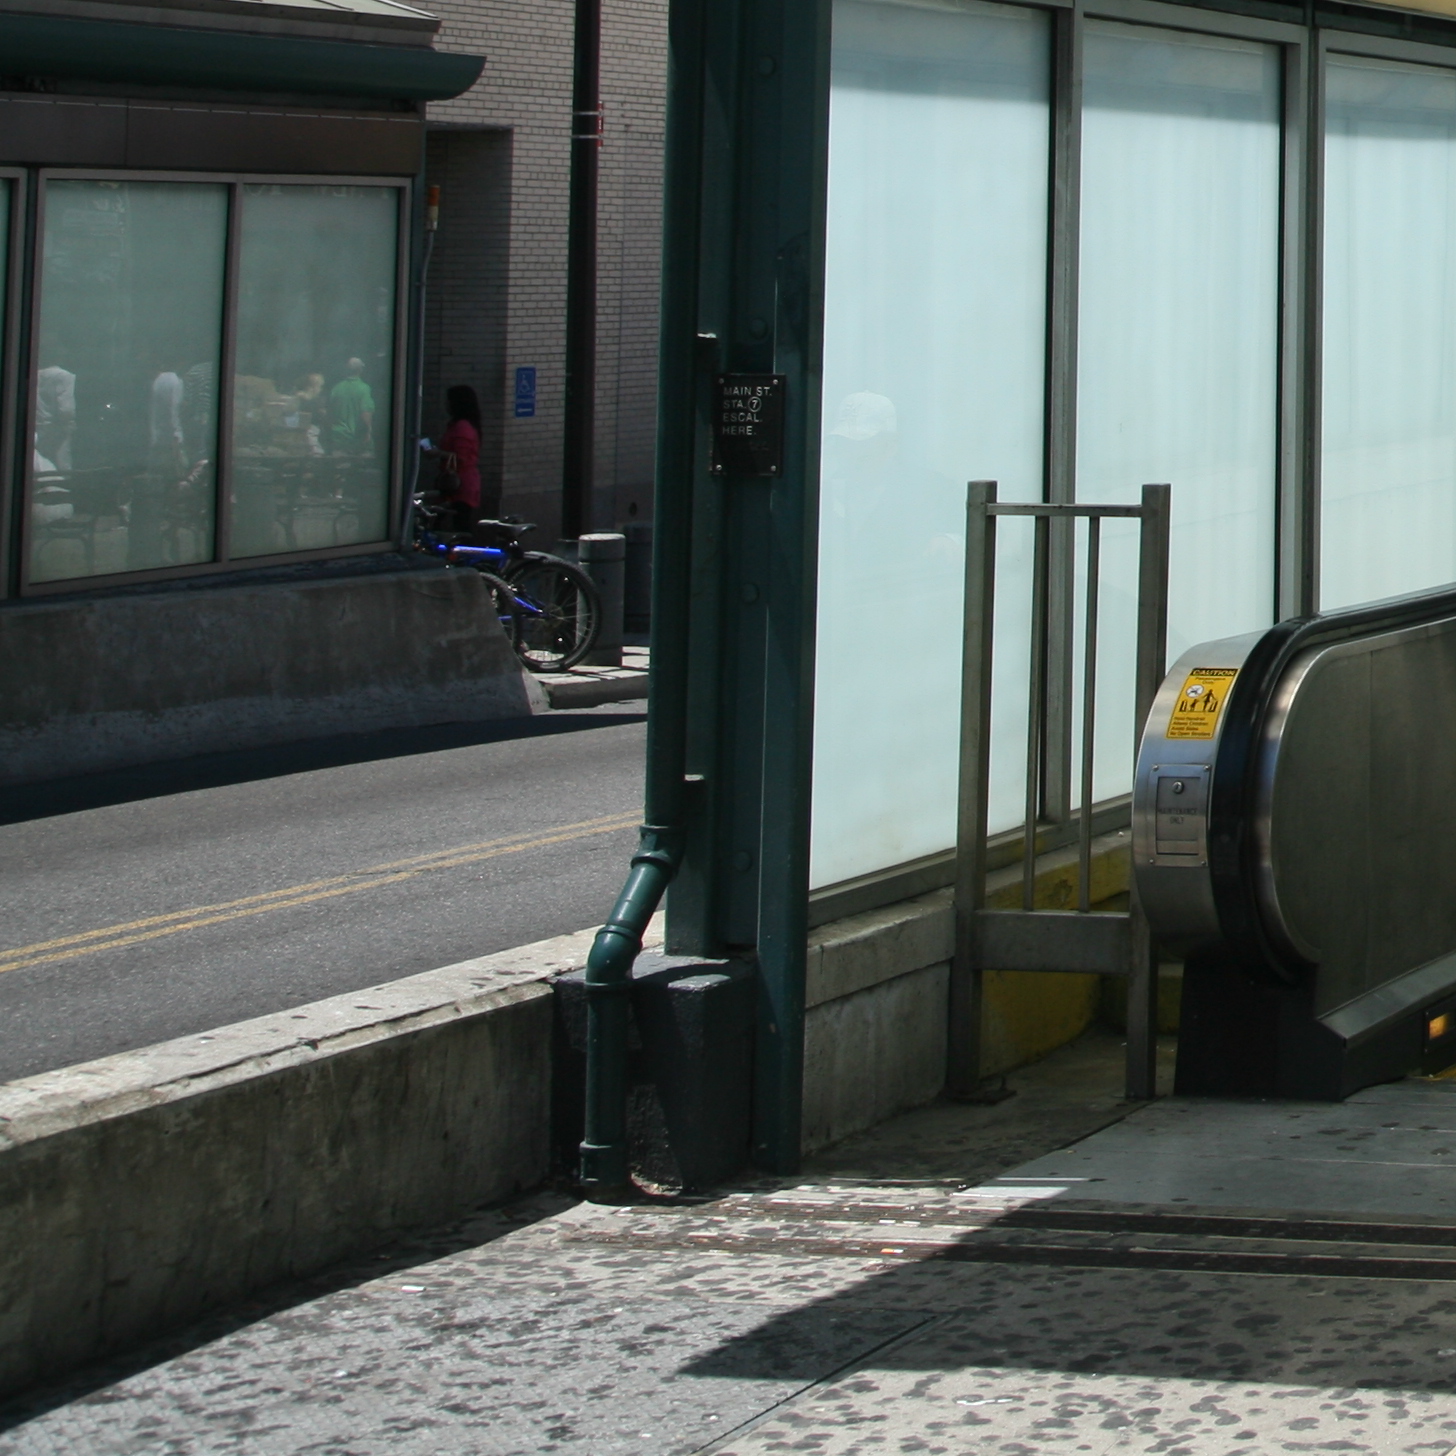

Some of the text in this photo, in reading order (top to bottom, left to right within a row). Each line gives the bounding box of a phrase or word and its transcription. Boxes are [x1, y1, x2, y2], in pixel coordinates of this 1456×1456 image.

[723, 386, 773, 396] MAIN ST.
[723, 399, 747, 409] STA.
[723, 412, 763, 422] ESCAL.
[722, 425, 757, 435] HERE.
[1192, 669, 1236, 677] CAUTION
